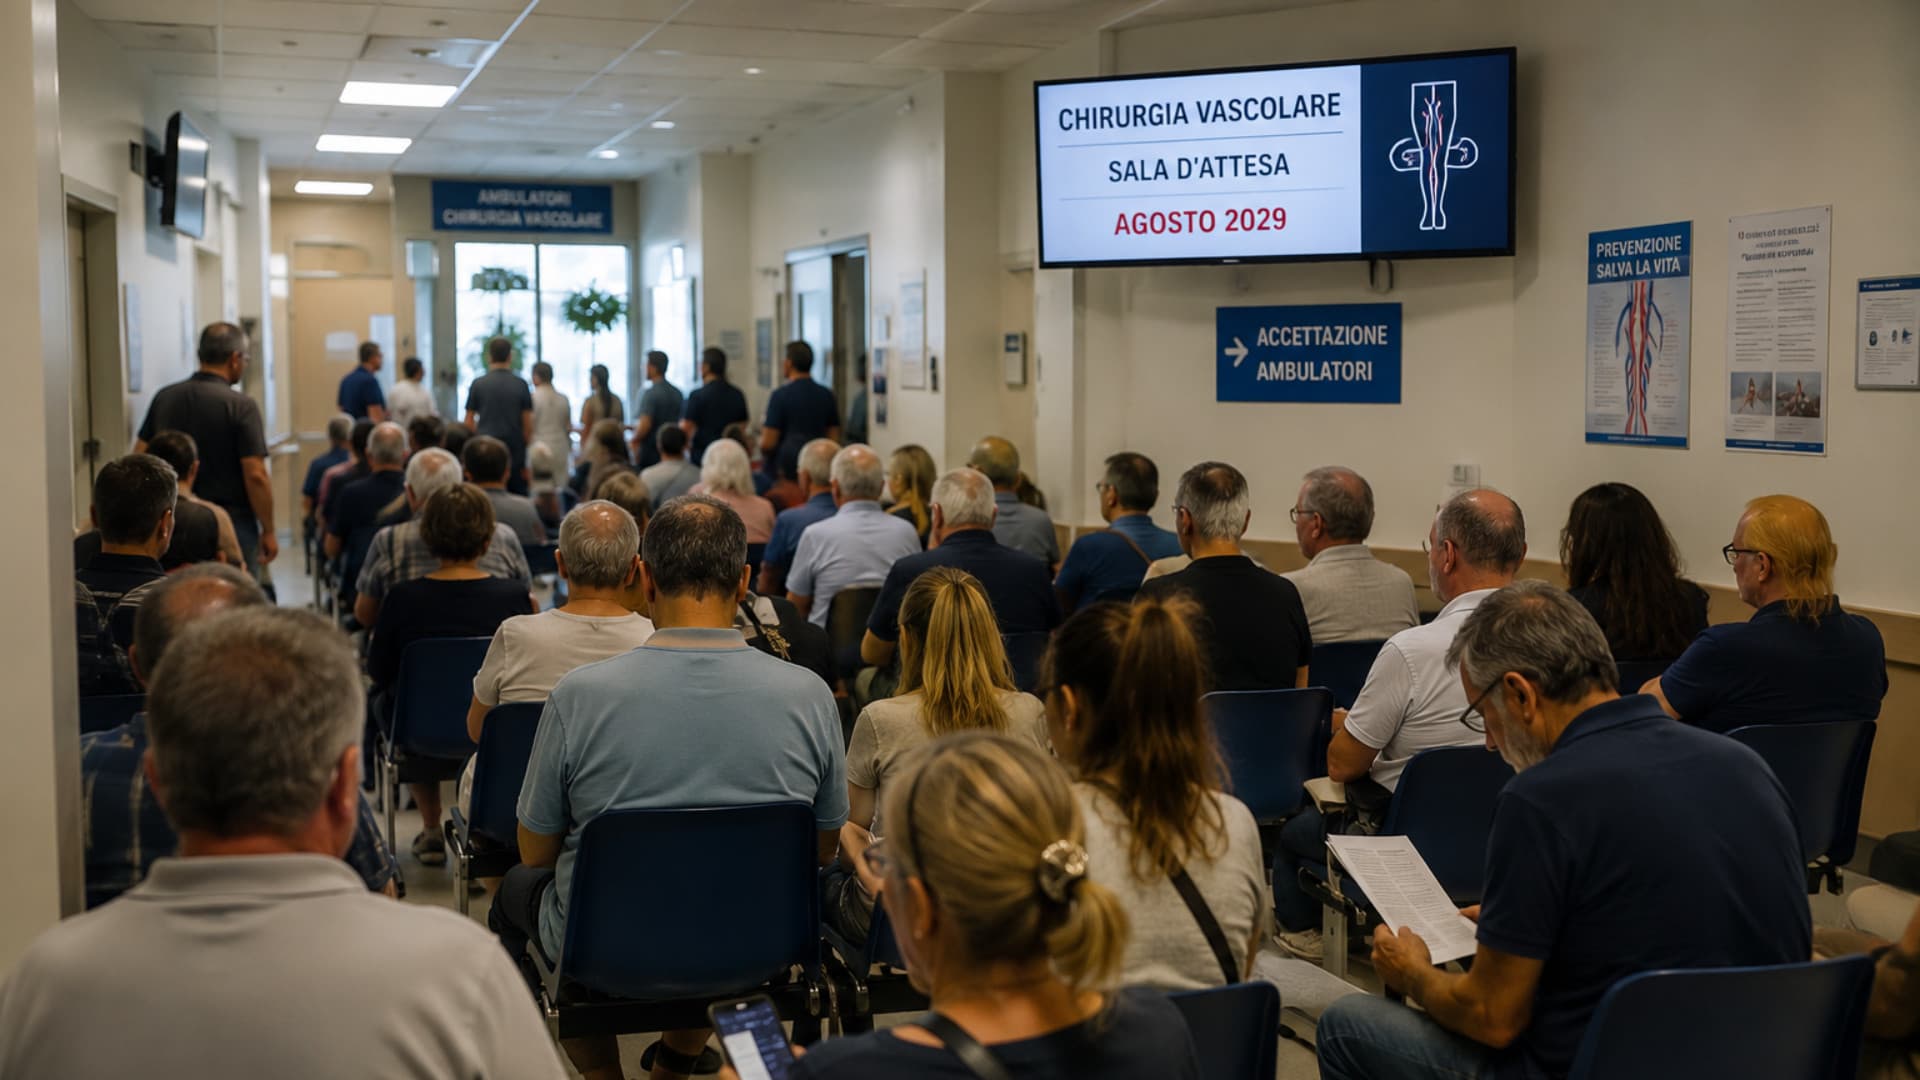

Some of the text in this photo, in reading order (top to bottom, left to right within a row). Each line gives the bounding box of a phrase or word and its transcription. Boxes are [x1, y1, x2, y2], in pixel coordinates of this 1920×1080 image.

[1058, 92, 1342, 132] CHIRURGIA VASCOLARE
[1108, 152, 1290, 182] SALA D'ATTESA
[478, 189, 571, 206] AMBULATORI
[443, 209, 603, 227] CHIRURGIA VASCOLARE
[1114, 206, 1287, 236] AGOSTO 2029
[1596, 234, 1682, 258] PREVENZIONE
[1596, 256, 1681, 278] SALVA LA VITA
[1256, 324, 1388, 346] ACCETTAZIONE
[1256, 360, 1373, 381] AMBULATORI
